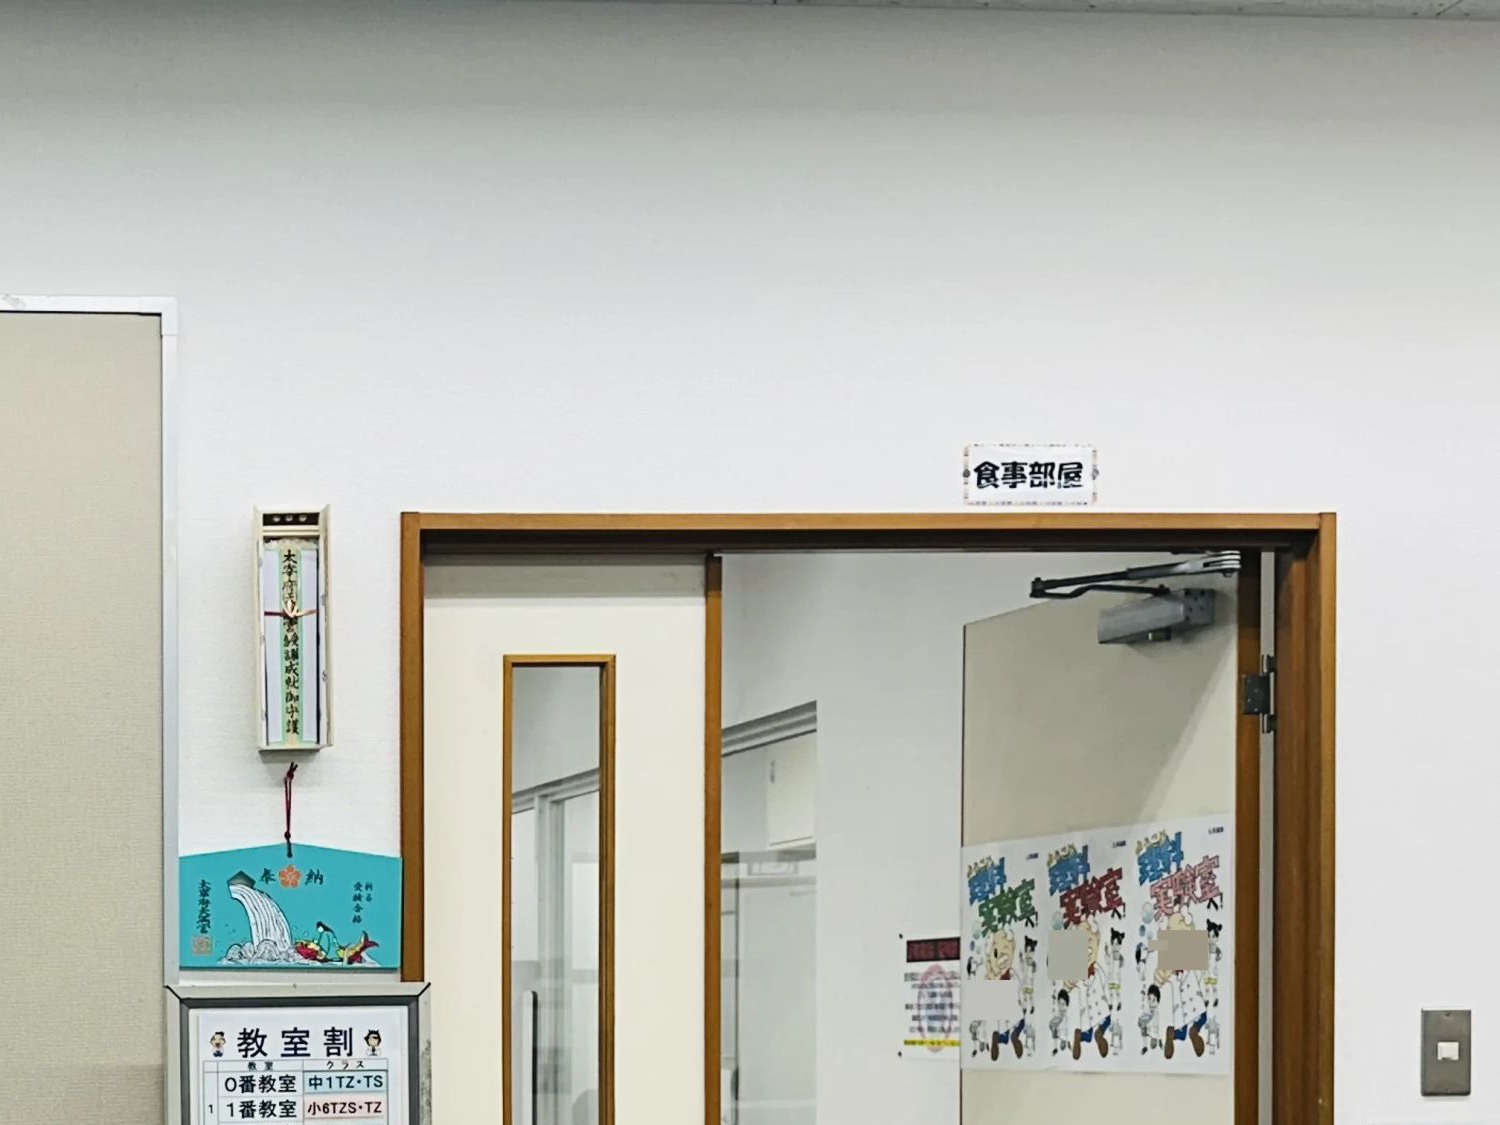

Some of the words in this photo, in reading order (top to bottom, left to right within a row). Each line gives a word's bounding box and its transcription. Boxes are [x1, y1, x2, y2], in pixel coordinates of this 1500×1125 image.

[974, 461, 1083, 488] 食事部屋
[237, 1027, 354, 1058] 教室割
[327, 1061, 365, 1070] クラス
[224, 1074, 297, 1094] 0番教室
[226, 1099, 297, 1119] 1番教室
